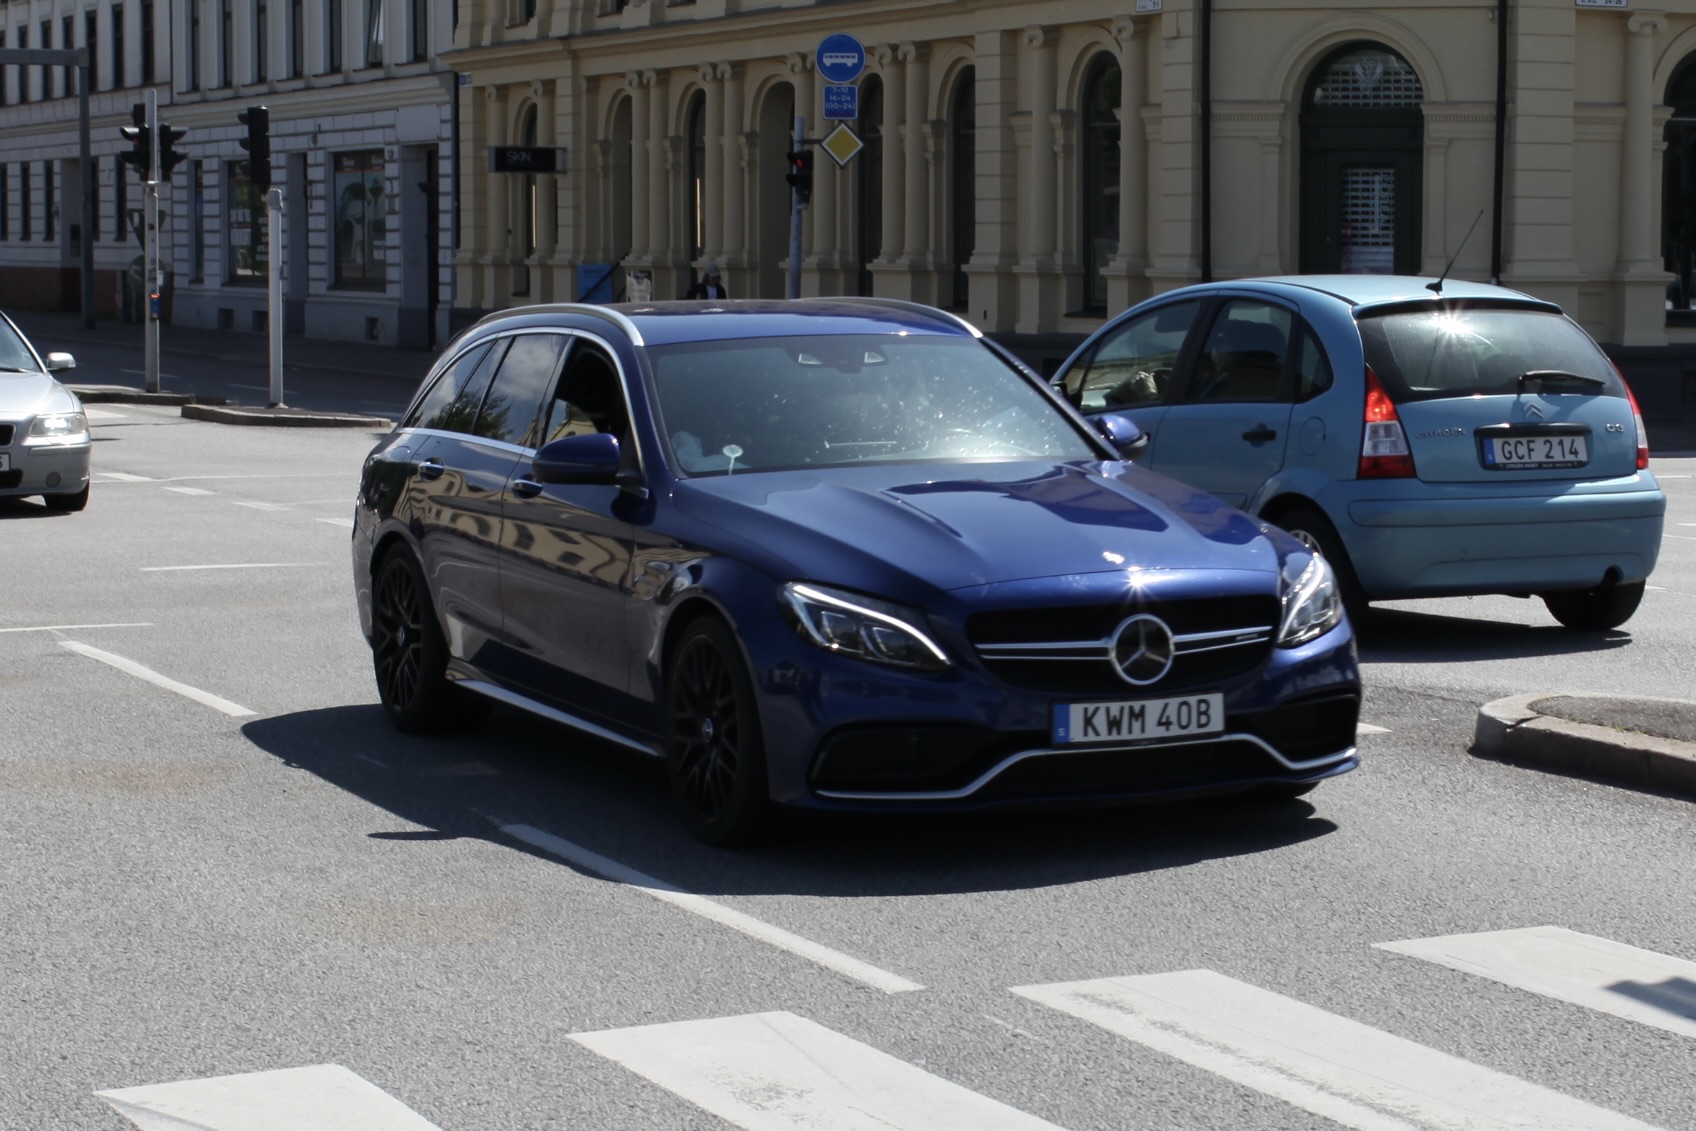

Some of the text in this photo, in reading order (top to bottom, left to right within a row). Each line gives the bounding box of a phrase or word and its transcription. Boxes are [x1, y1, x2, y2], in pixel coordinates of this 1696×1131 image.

[1502, 439, 1579, 461] GCF 214
[1083, 699, 1211, 737] KWM 40B
[1058, 728, 1065, 736] S
